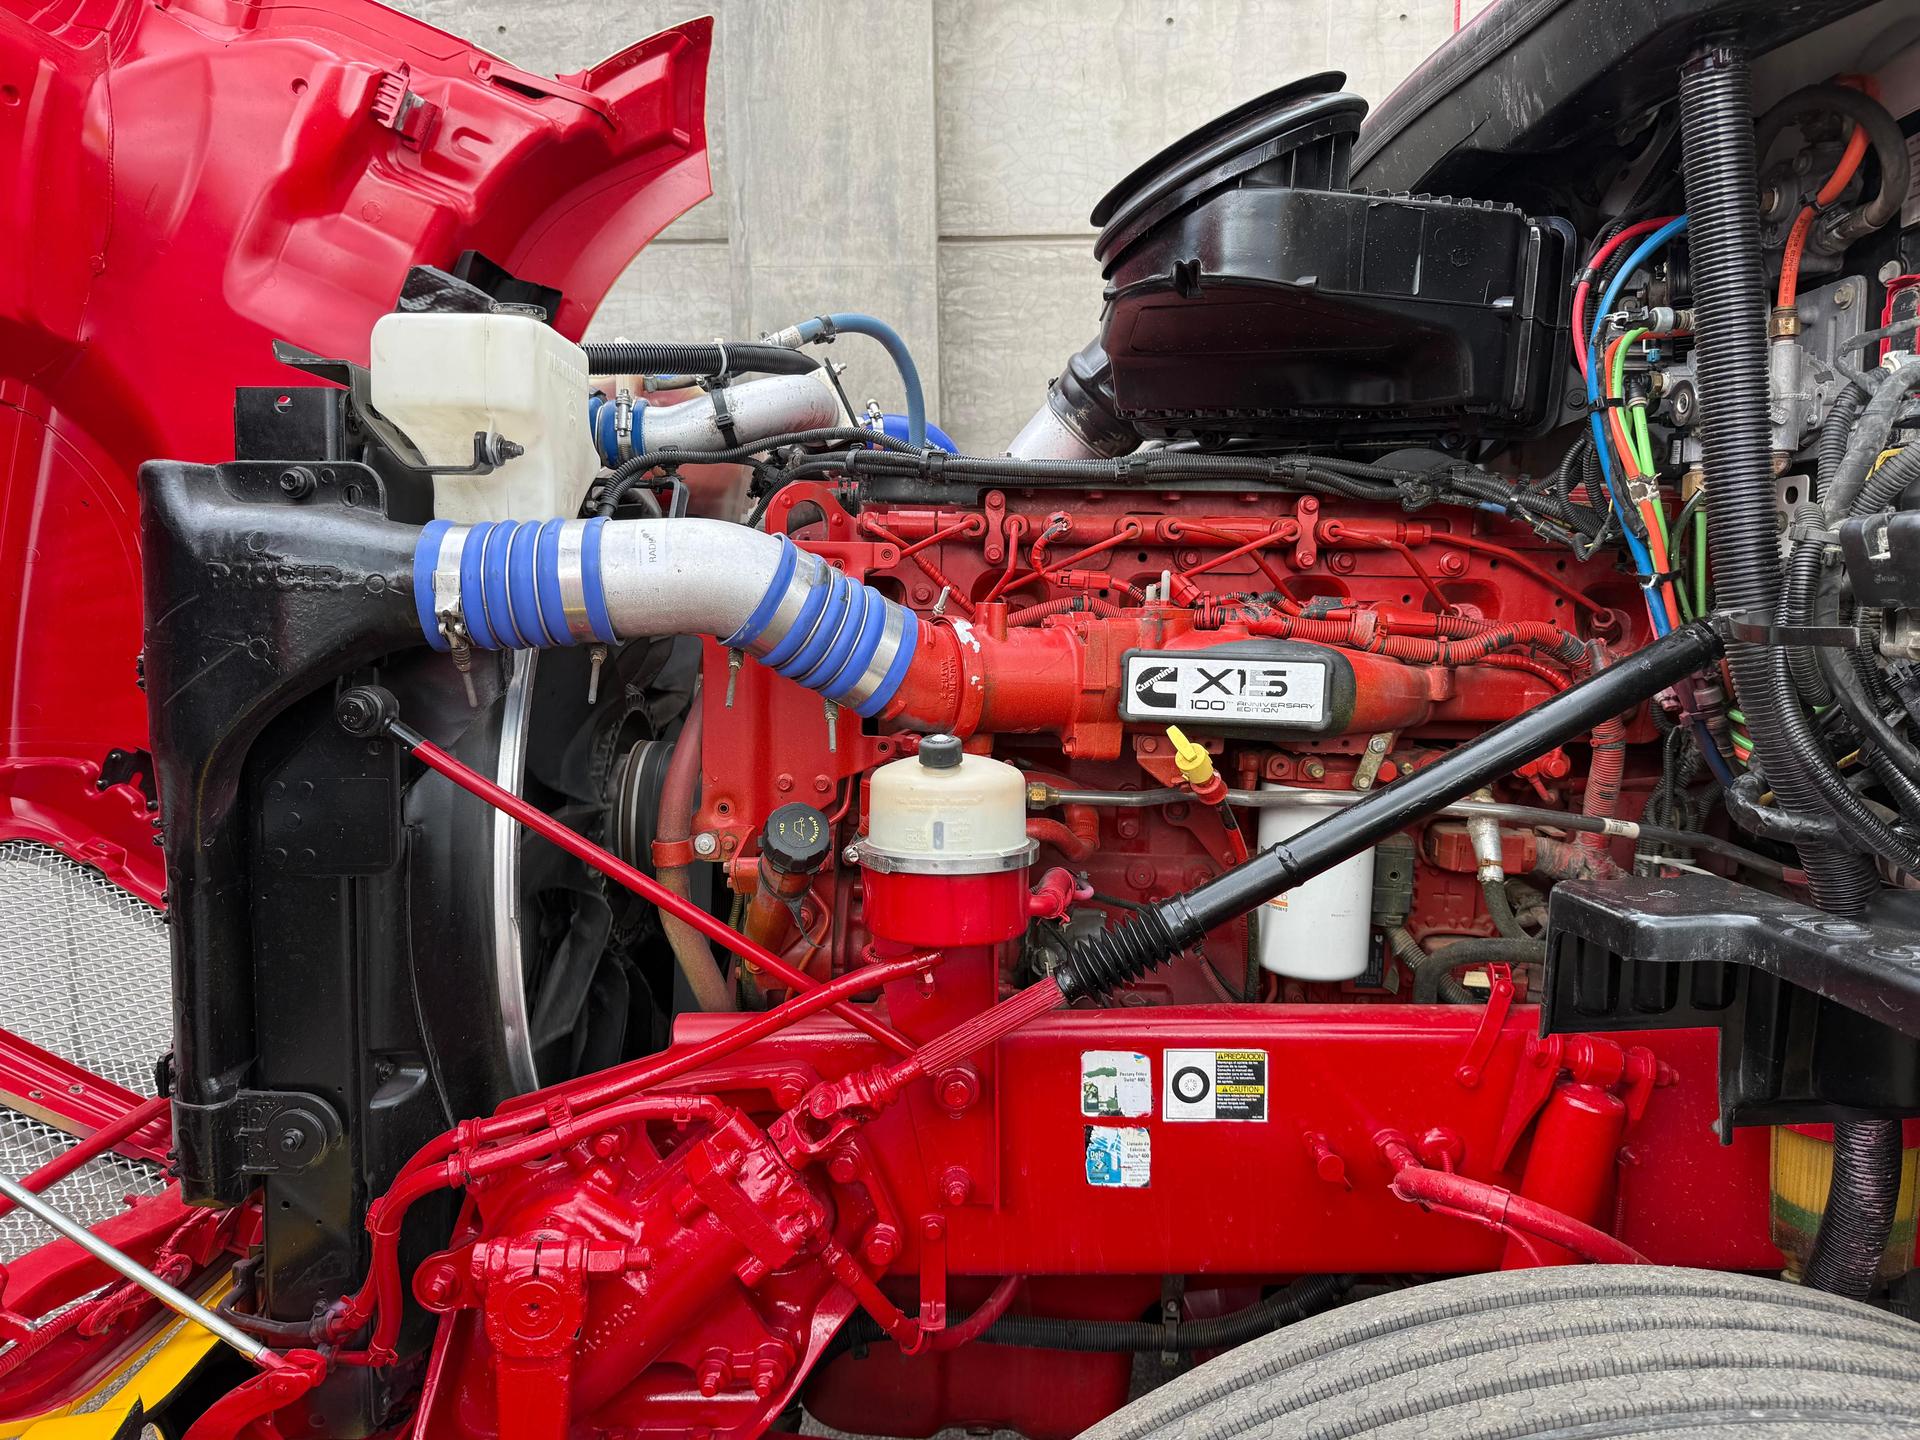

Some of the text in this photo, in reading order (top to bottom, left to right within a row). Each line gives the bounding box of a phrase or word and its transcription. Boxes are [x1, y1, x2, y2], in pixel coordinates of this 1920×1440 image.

[1135, 666, 1176, 693] Cummins
[1193, 668, 1288, 697] X15
[1236, 700, 1315, 709] ANNIVERSARY
[808, 816, 820, 843] ENGINE
